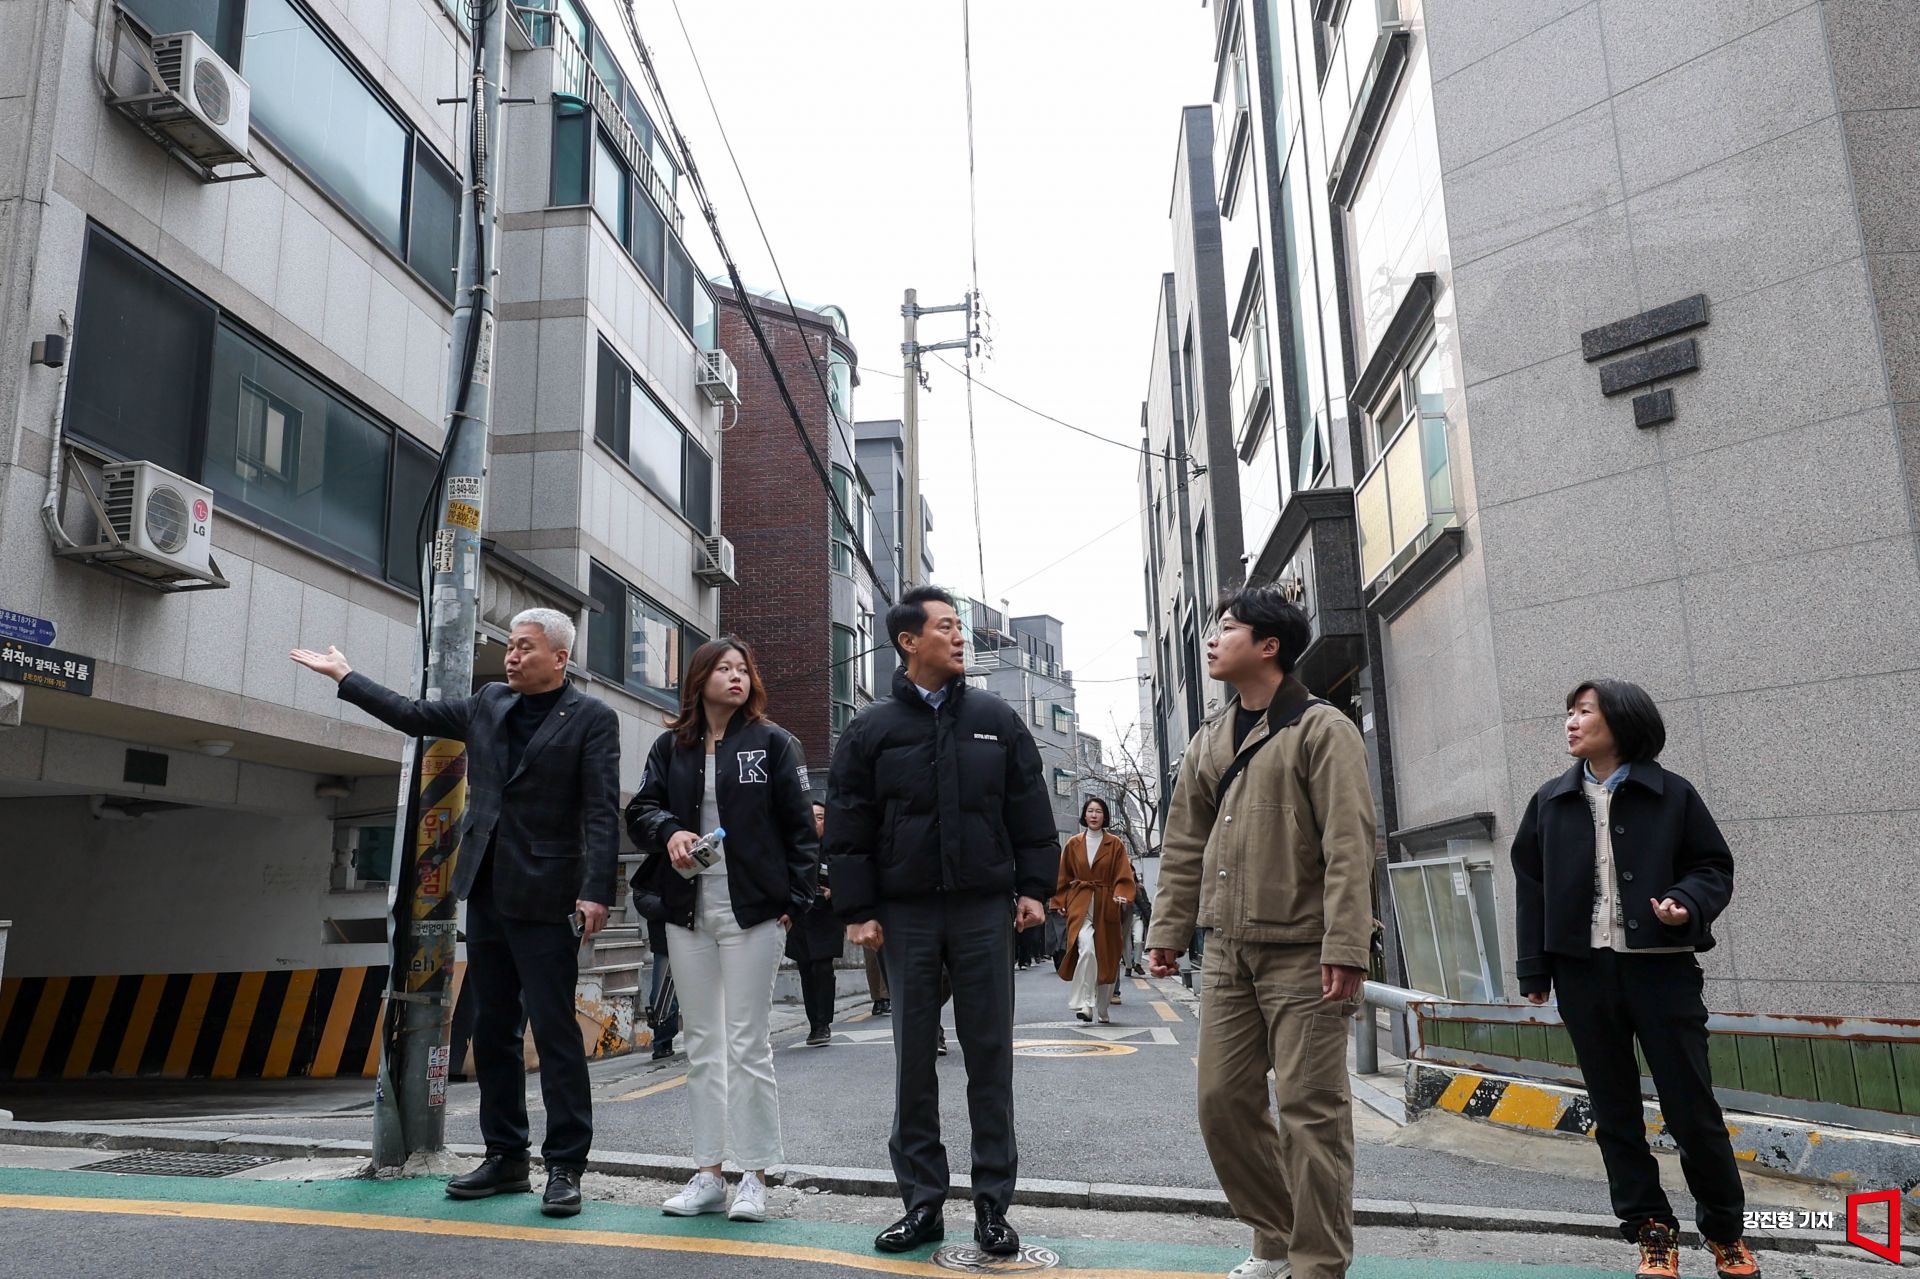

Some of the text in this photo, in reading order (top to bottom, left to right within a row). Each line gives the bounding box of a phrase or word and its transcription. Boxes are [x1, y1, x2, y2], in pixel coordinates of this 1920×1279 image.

[193, 523, 206, 537] LG
[1, 647, 90, 681] 취직이 잘되는 원룸
[737, 749, 768, 783] K
